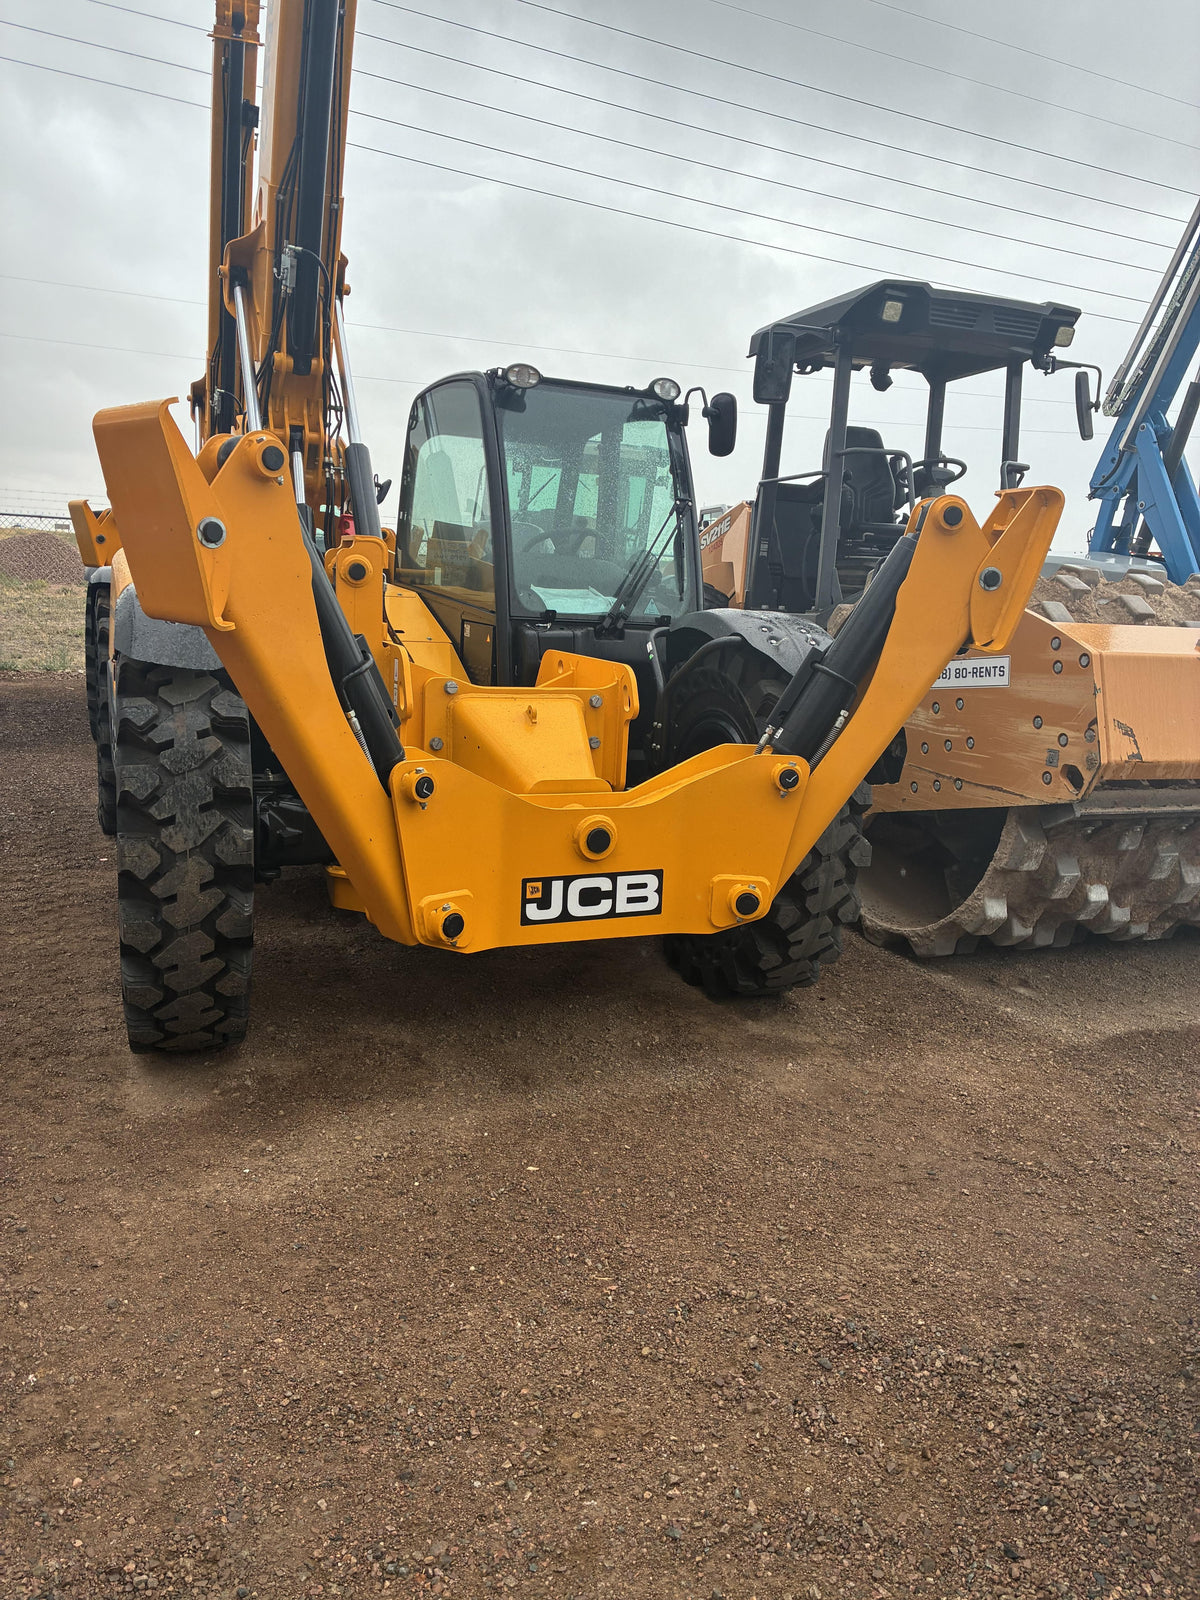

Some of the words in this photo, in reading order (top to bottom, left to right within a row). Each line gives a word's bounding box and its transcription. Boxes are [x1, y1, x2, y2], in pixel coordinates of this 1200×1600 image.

[700, 516, 731, 550] SV211E
[938, 668, 951, 680] 8)
[954, 666, 1005, 679] 80-RENTS
[525, 873, 660, 921] JCB
